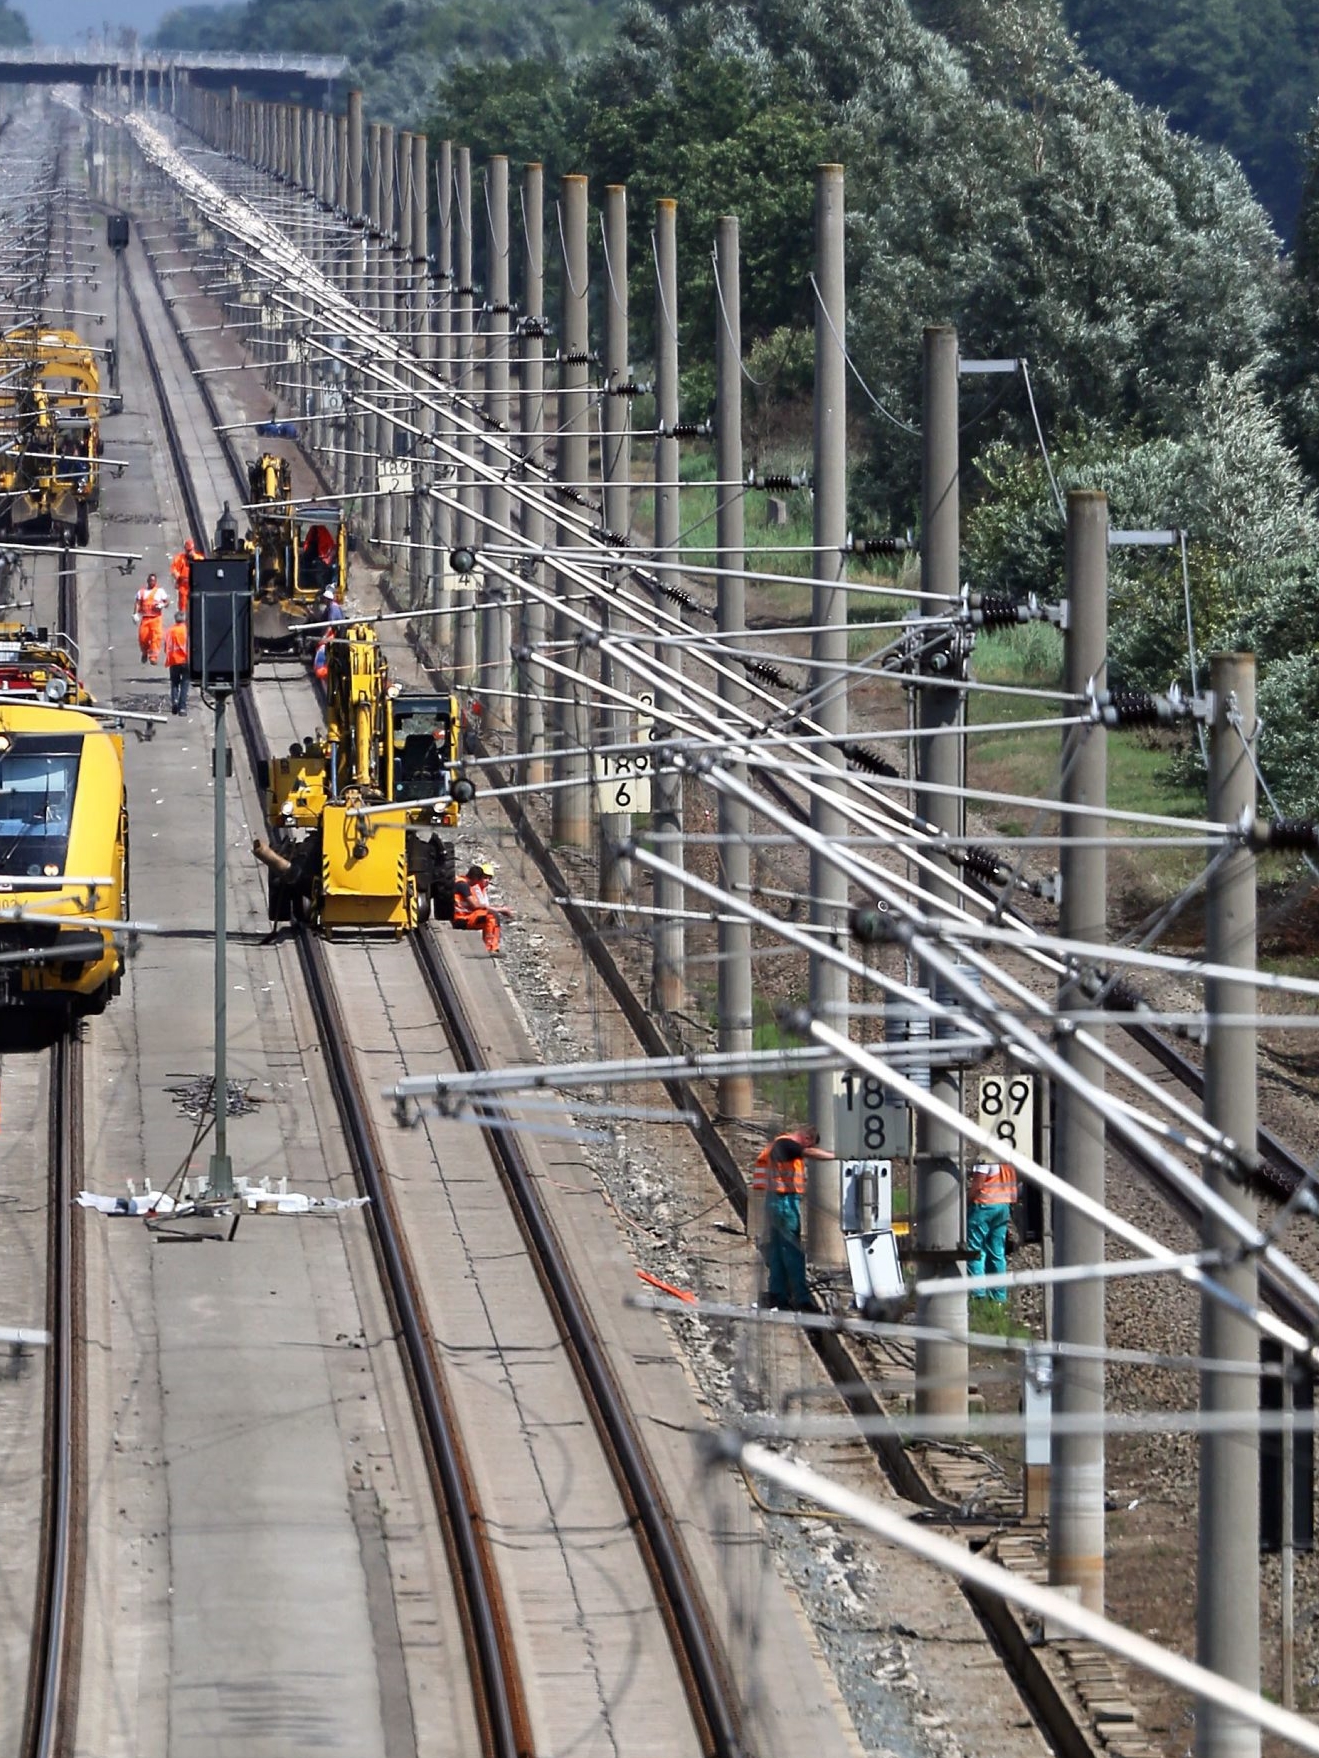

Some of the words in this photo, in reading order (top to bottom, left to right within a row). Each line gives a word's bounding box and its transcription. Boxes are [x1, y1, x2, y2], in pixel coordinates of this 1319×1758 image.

[380, 461, 409, 475] 189
[458, 573, 470, 586] 4
[601, 754, 648, 779] 189
[615, 782, 631, 807] 6
[981, 1081, 1029, 1116] 89
[863, 1114, 885, 1149] 8
[997, 1119, 1017, 1149] 8
